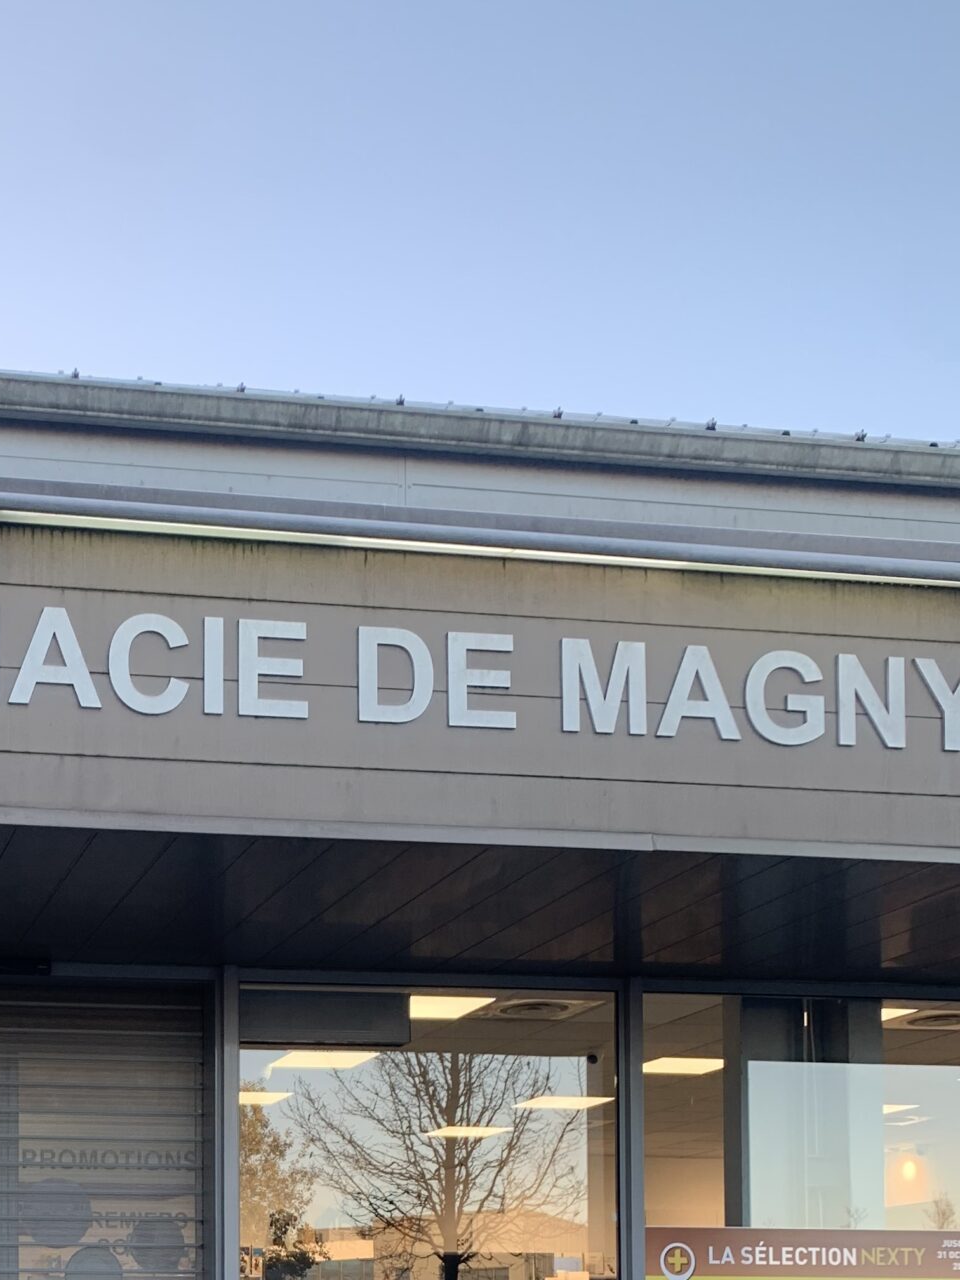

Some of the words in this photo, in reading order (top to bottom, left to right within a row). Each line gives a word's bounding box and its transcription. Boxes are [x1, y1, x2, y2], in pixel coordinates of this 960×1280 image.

[357, 626, 517, 730] DE
[561, 638, 960, 752] MAGNY
[22, 1149, 196, 1171] PROMOTIONS
[708, 1246, 735, 1264] LA
[741, 1241, 856, 1266] SÉLECTION
[861, 1247, 926, 1266] NEXTY
